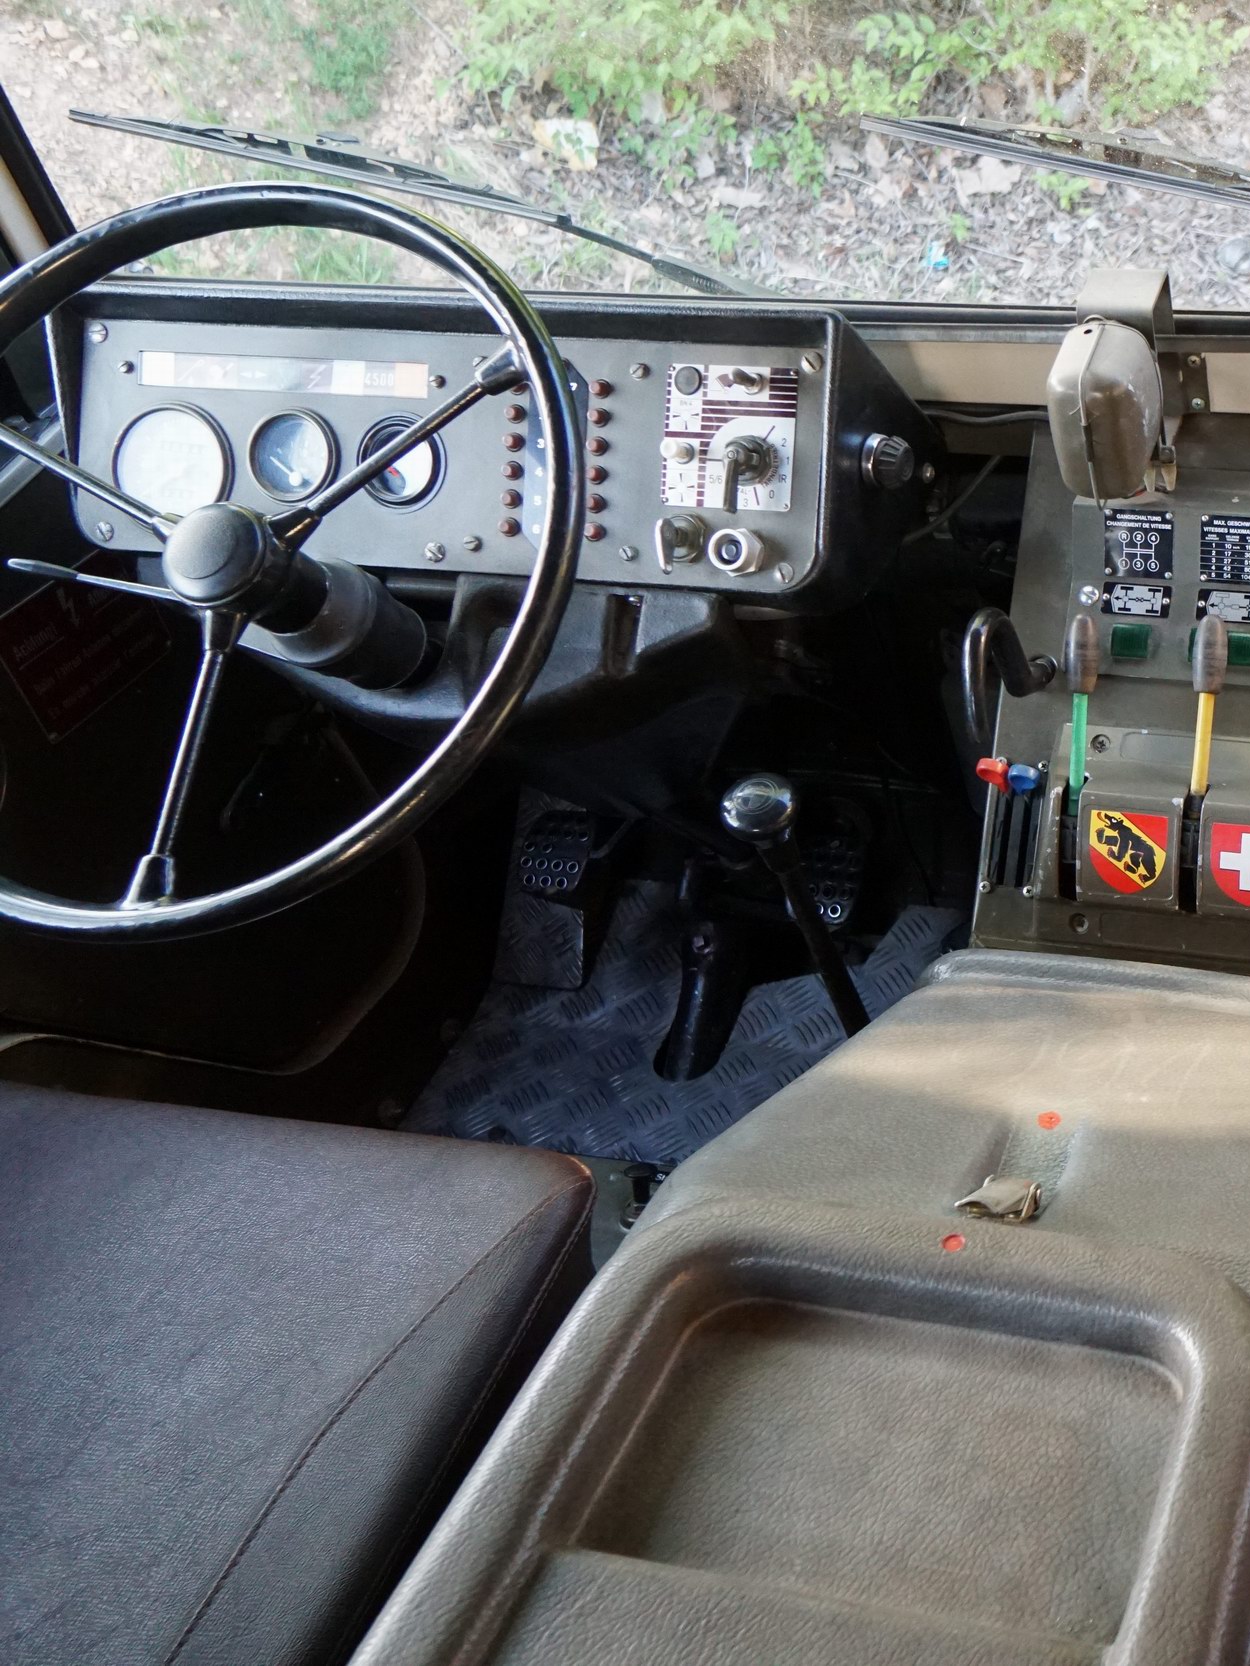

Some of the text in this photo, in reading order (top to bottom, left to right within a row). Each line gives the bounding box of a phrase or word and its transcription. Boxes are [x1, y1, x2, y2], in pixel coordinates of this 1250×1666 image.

[364, 372, 395, 387] 4500
[536, 438, 545, 448] 3
[781, 438, 787, 447] 2
[535, 468, 543, 477] 4
[709, 475, 723, 484] 5/6
[778, 474, 787, 484] IR
[534, 496, 542, 505] 5
[743, 498, 748, 507] 3
[1106, 520, 1141, 528] CHANGEMENT
[532, 525, 540, 534] 6
